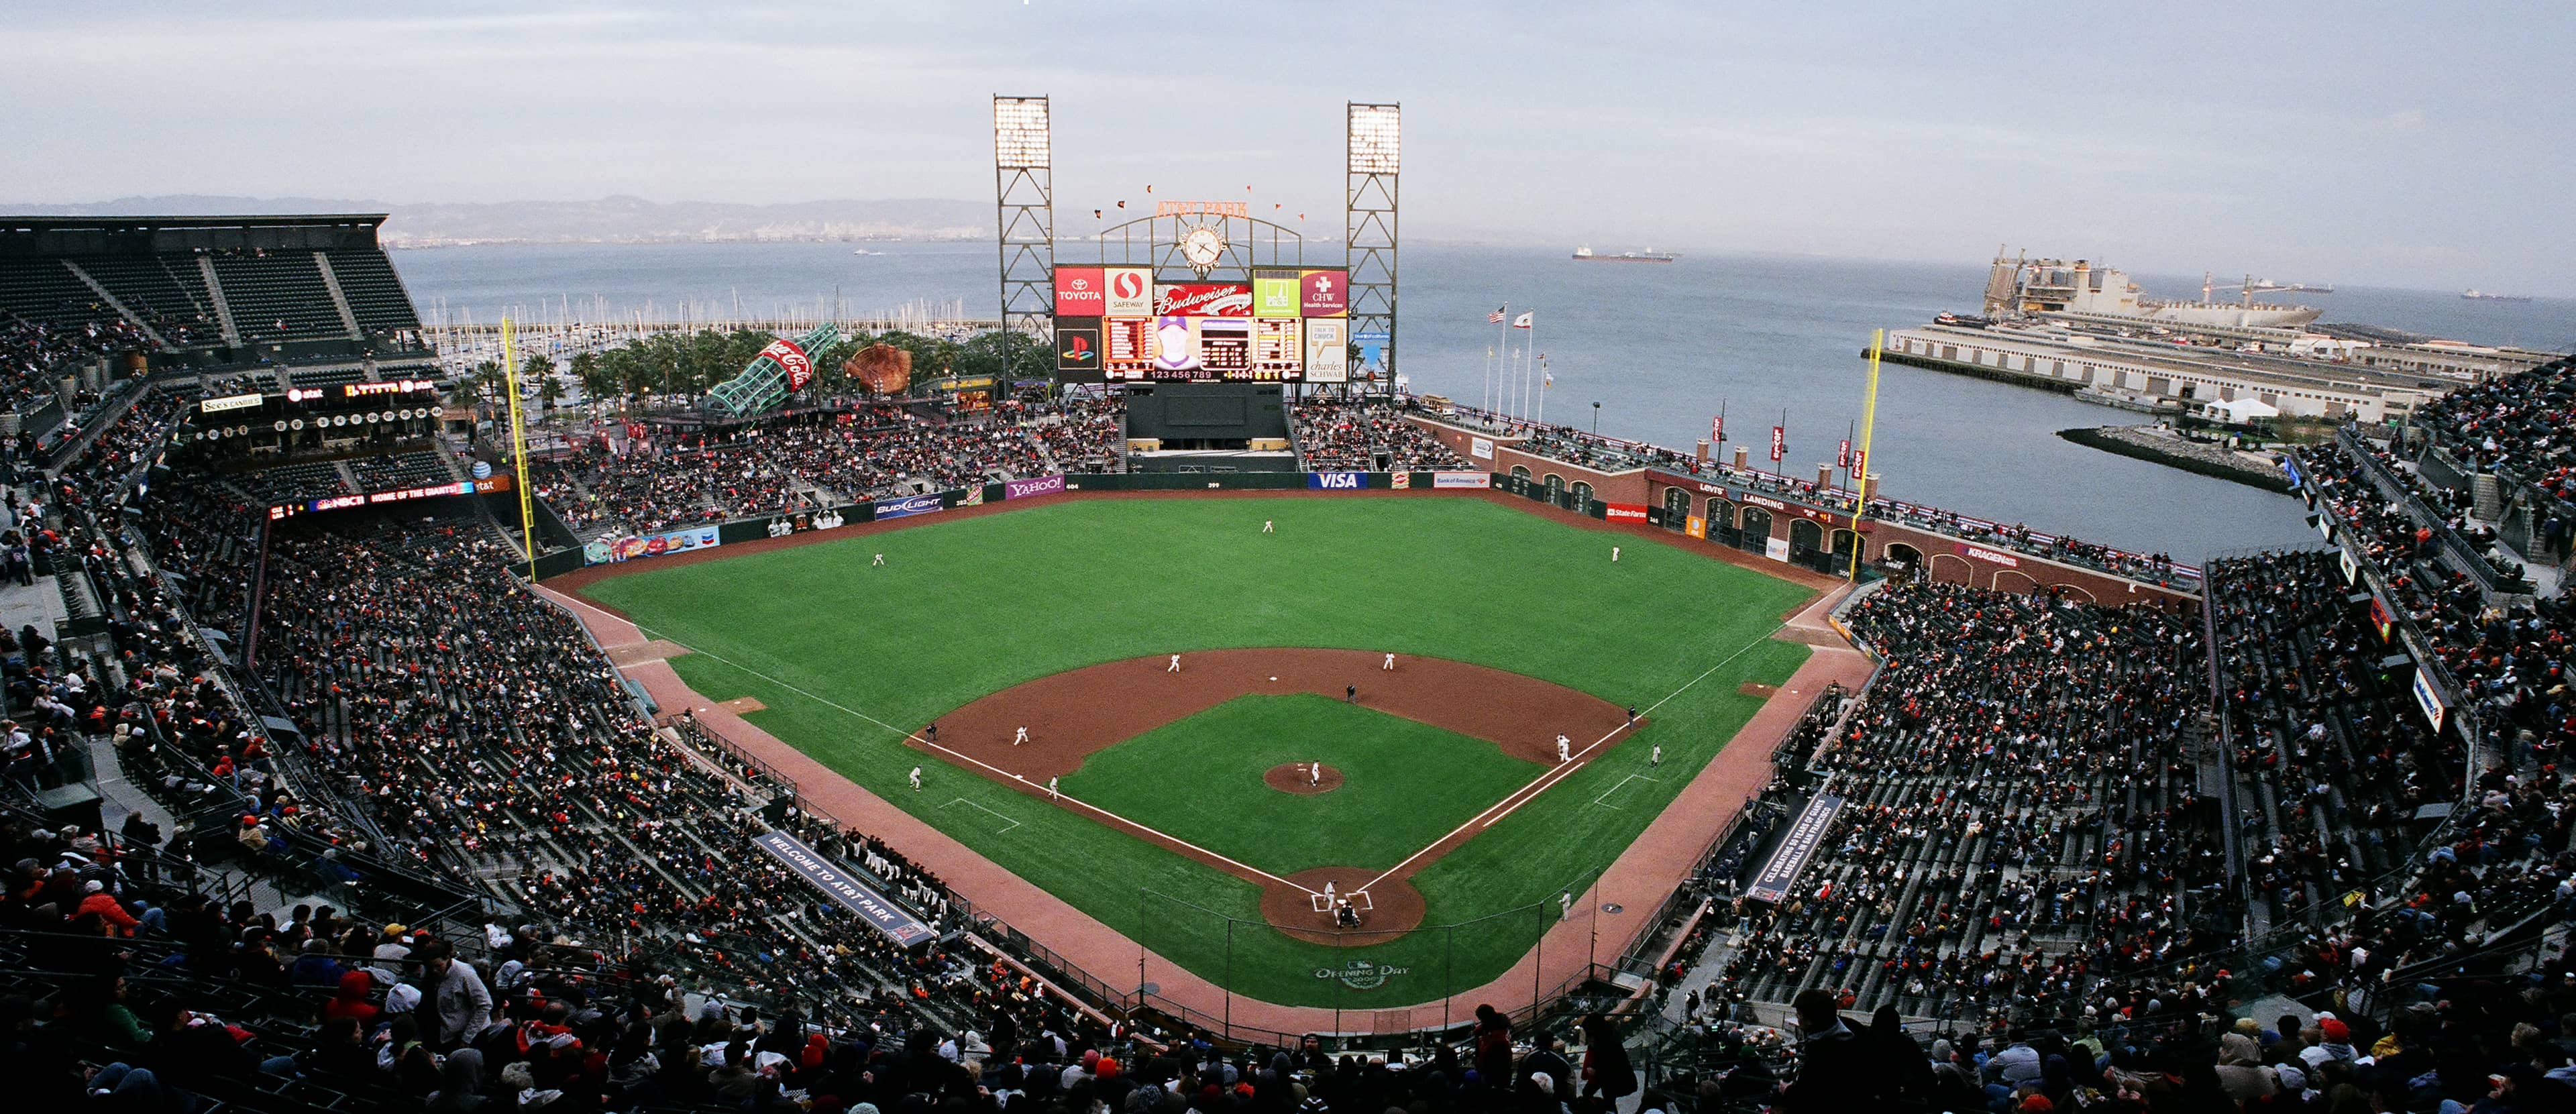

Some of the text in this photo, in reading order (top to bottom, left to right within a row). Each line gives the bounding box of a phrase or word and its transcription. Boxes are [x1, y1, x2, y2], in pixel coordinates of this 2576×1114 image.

[1155, 202, 1248, 219] AT&T PARK
[1178, 223, 1228, 250] SAN FRANCISCO
[1186, 260, 1220, 273] GIANTS
[1059, 291, 1102, 300] TOYOTA
[1155, 286, 1237, 315] Budweiser
[1312, 293, 1334, 302] CHW
[1309, 361, 1342, 371] charles
[413, 380, 433, 390] at&t
[303, 389, 323, 398] at&t
[205, 398, 260, 410] See's CANDIES
[1010, 477, 1061, 497] YAHOO!
[1318, 474, 1357, 488] VISA
[371, 485, 458, 502] HOME OF THE GIANTS!
[877, 498, 941, 514] BUD LIGHT
[1743, 494, 1784, 510] LANDING
[1968, 547, 2004, 564] KRAGEN
[1838, 569, 1850, 577] 309
[2129, 583, 2137, 594] K
[1764, 846, 1794, 883] CELEBRATING
[1792, 822, 1810, 839] YEARS
[1809, 799, 1825, 816] GIANTS
[1780, 850, 1805, 879] BASEBALL
[1802, 833, 1815, 844] SAN
[1809, 807, 1832, 834] FRANCISCO
[769, 836, 896, 922] WELCOME TO AT&T PARK
[1315, 964, 1410, 979] OPENING DAY
